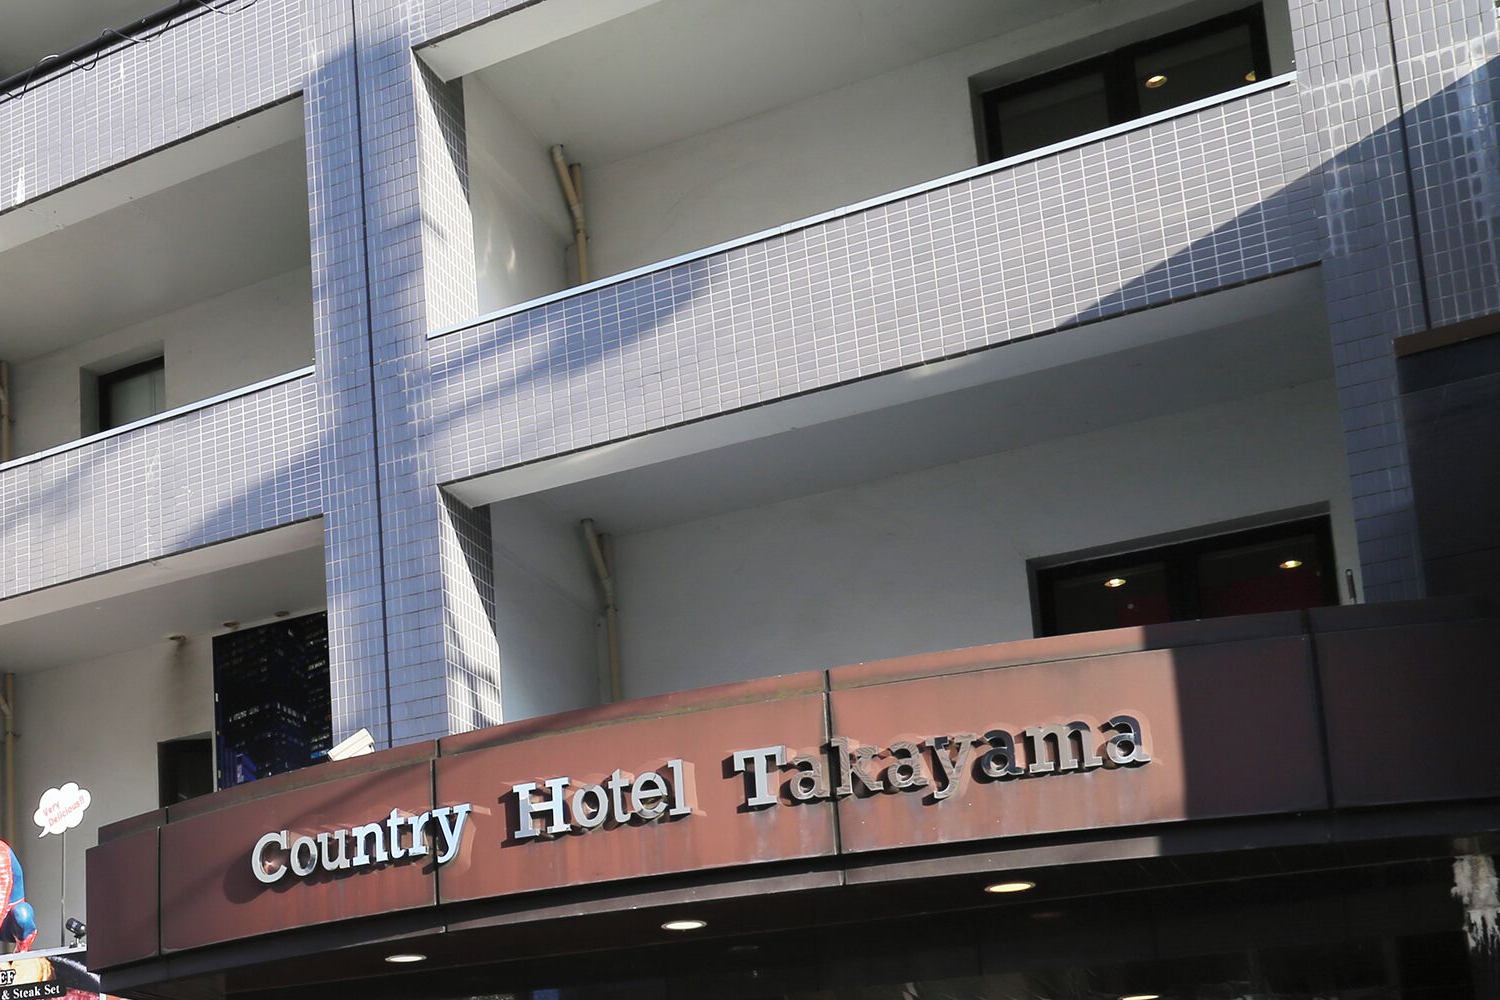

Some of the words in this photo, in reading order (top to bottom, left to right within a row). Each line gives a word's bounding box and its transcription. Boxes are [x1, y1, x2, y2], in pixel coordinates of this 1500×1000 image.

[250, 800, 472, 885] Country
[512, 758, 693, 841] Hotel
[733, 713, 1151, 810] Takayama
[1, 990, 10, 1000] &
[13, 986, 41, 999] Steak
[44, 984, 60, 995] Set
